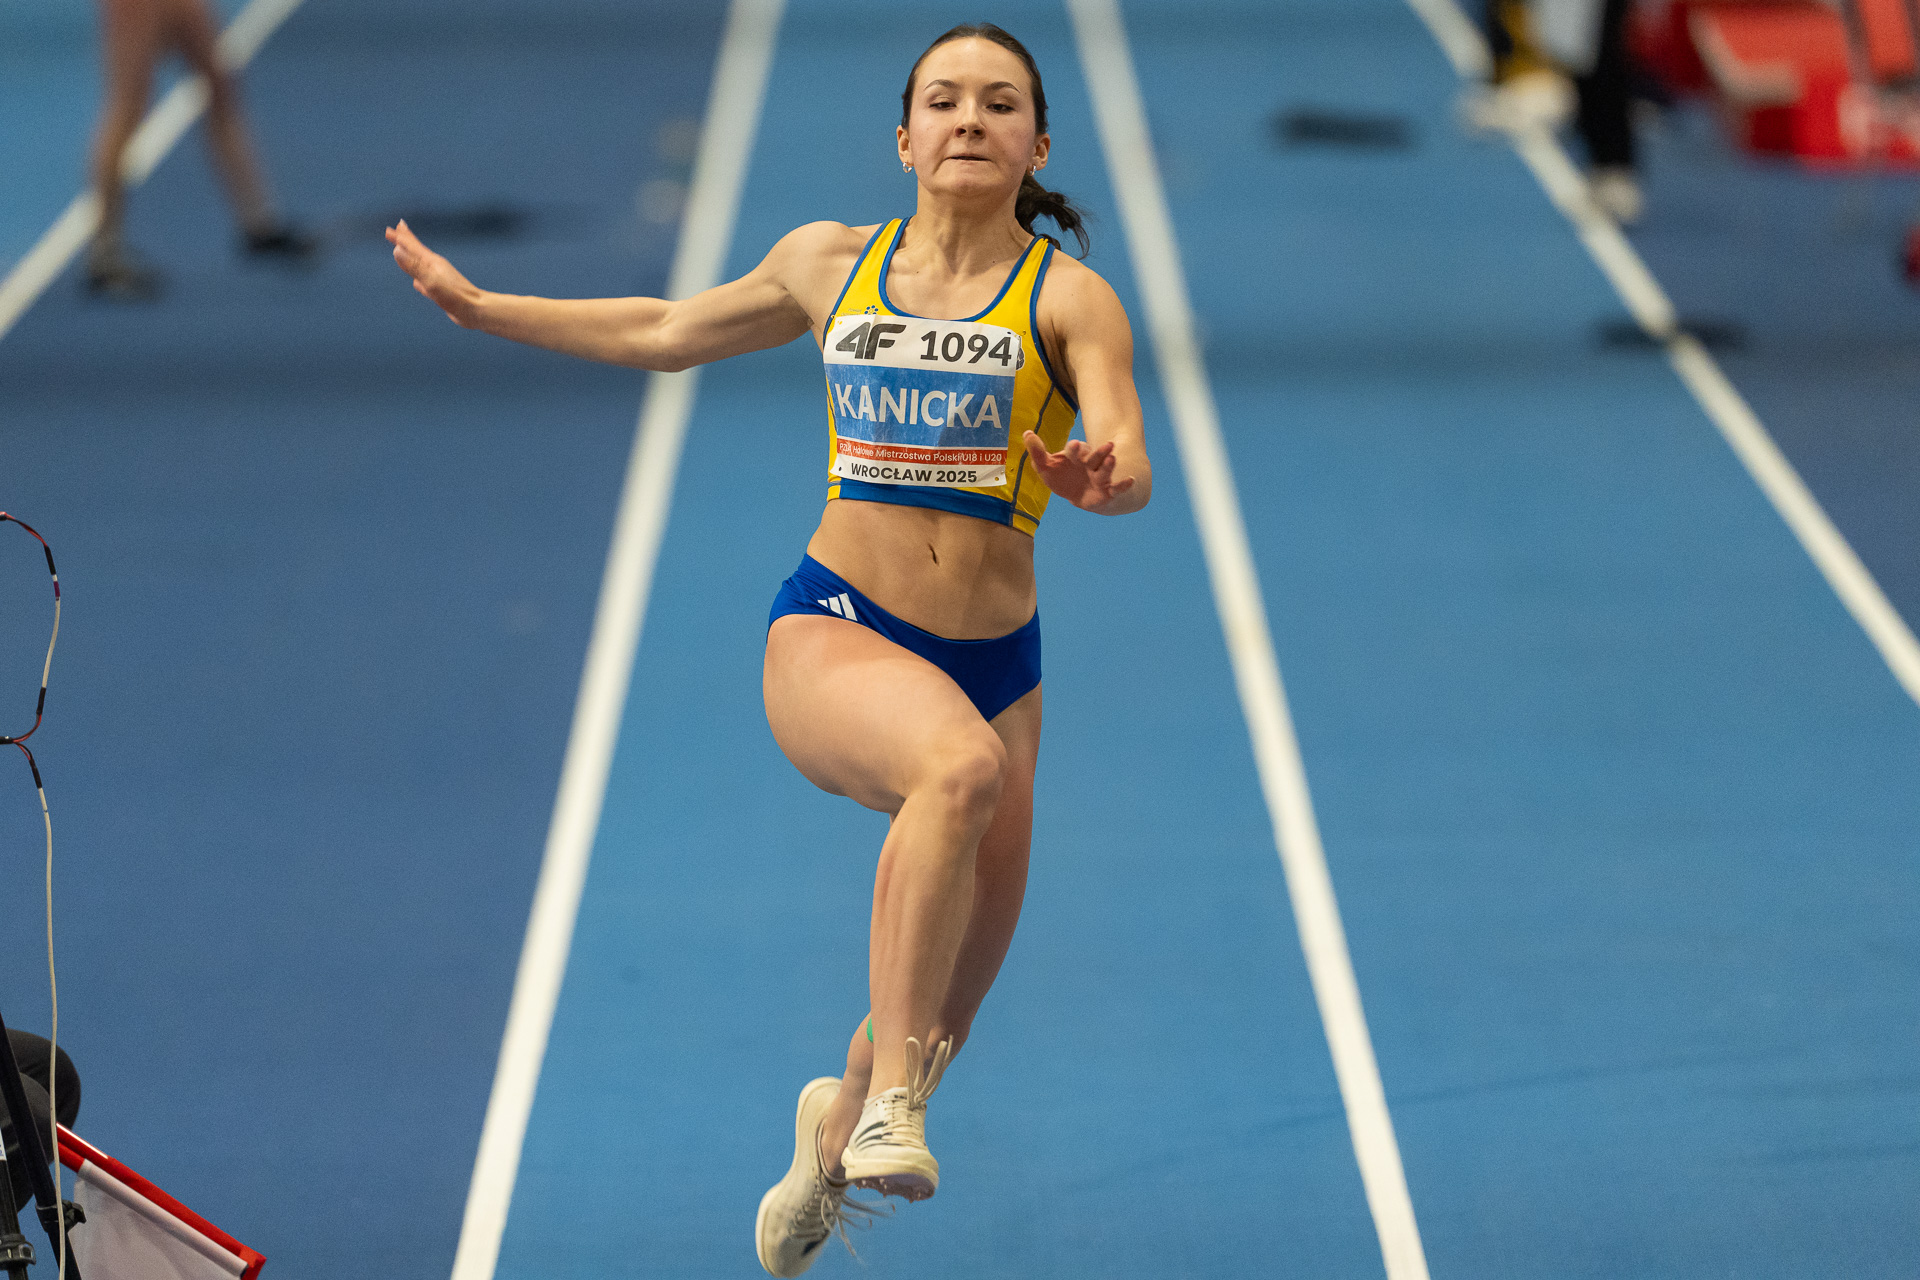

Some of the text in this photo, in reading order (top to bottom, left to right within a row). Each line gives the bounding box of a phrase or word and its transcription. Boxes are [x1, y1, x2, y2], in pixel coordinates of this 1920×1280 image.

[836, 322, 1012, 367] 4F 1094
[835, 383, 1002, 429] KANICKA
[853, 446, 874, 457] Halowe
[875, 449, 932, 461] Mistrzostwa
[934, 453, 960, 462] Polski
[962, 453, 978, 462] U18
[984, 453, 1002, 462] U20
[851, 462, 977, 483] WROCŁAW 2025
